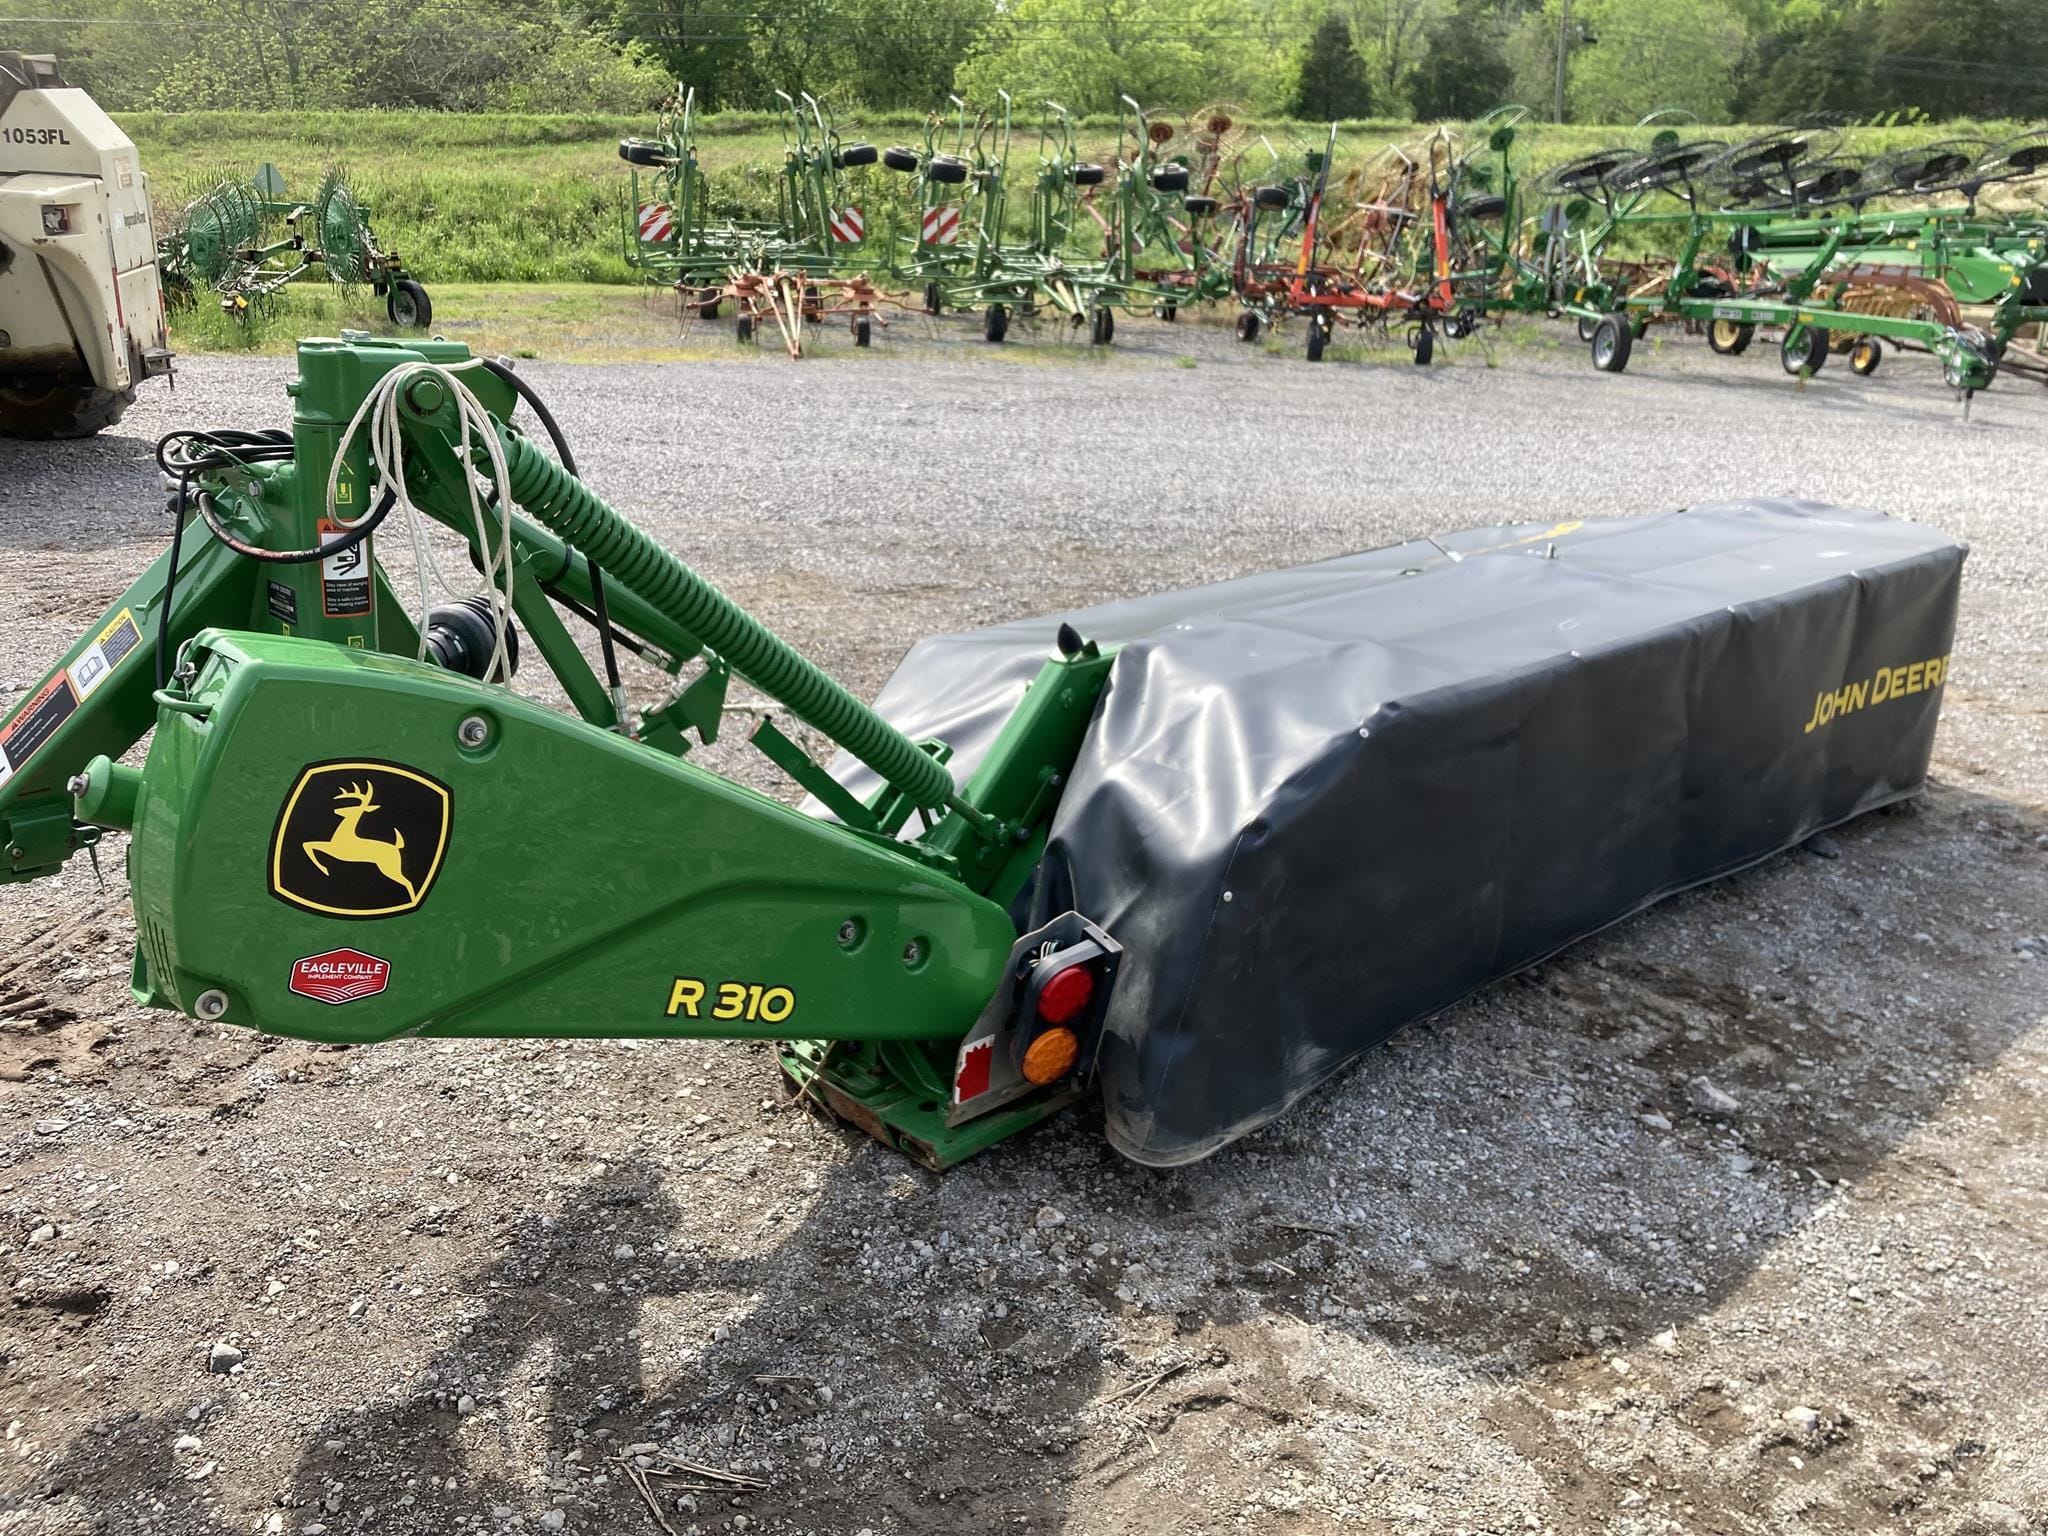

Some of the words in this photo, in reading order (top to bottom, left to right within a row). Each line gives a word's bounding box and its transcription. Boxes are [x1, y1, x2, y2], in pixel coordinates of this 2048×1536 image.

[3, 128, 70, 145] 1053FL
[105, 615, 126, 637] CAUTION
[17, 688, 49, 724] WARNING
[1804, 678, 1870, 734] JOHN
[301, 962, 383, 974] EAGLEVILLE
[666, 978, 705, 1017] R
[712, 982, 795, 1023] 310
